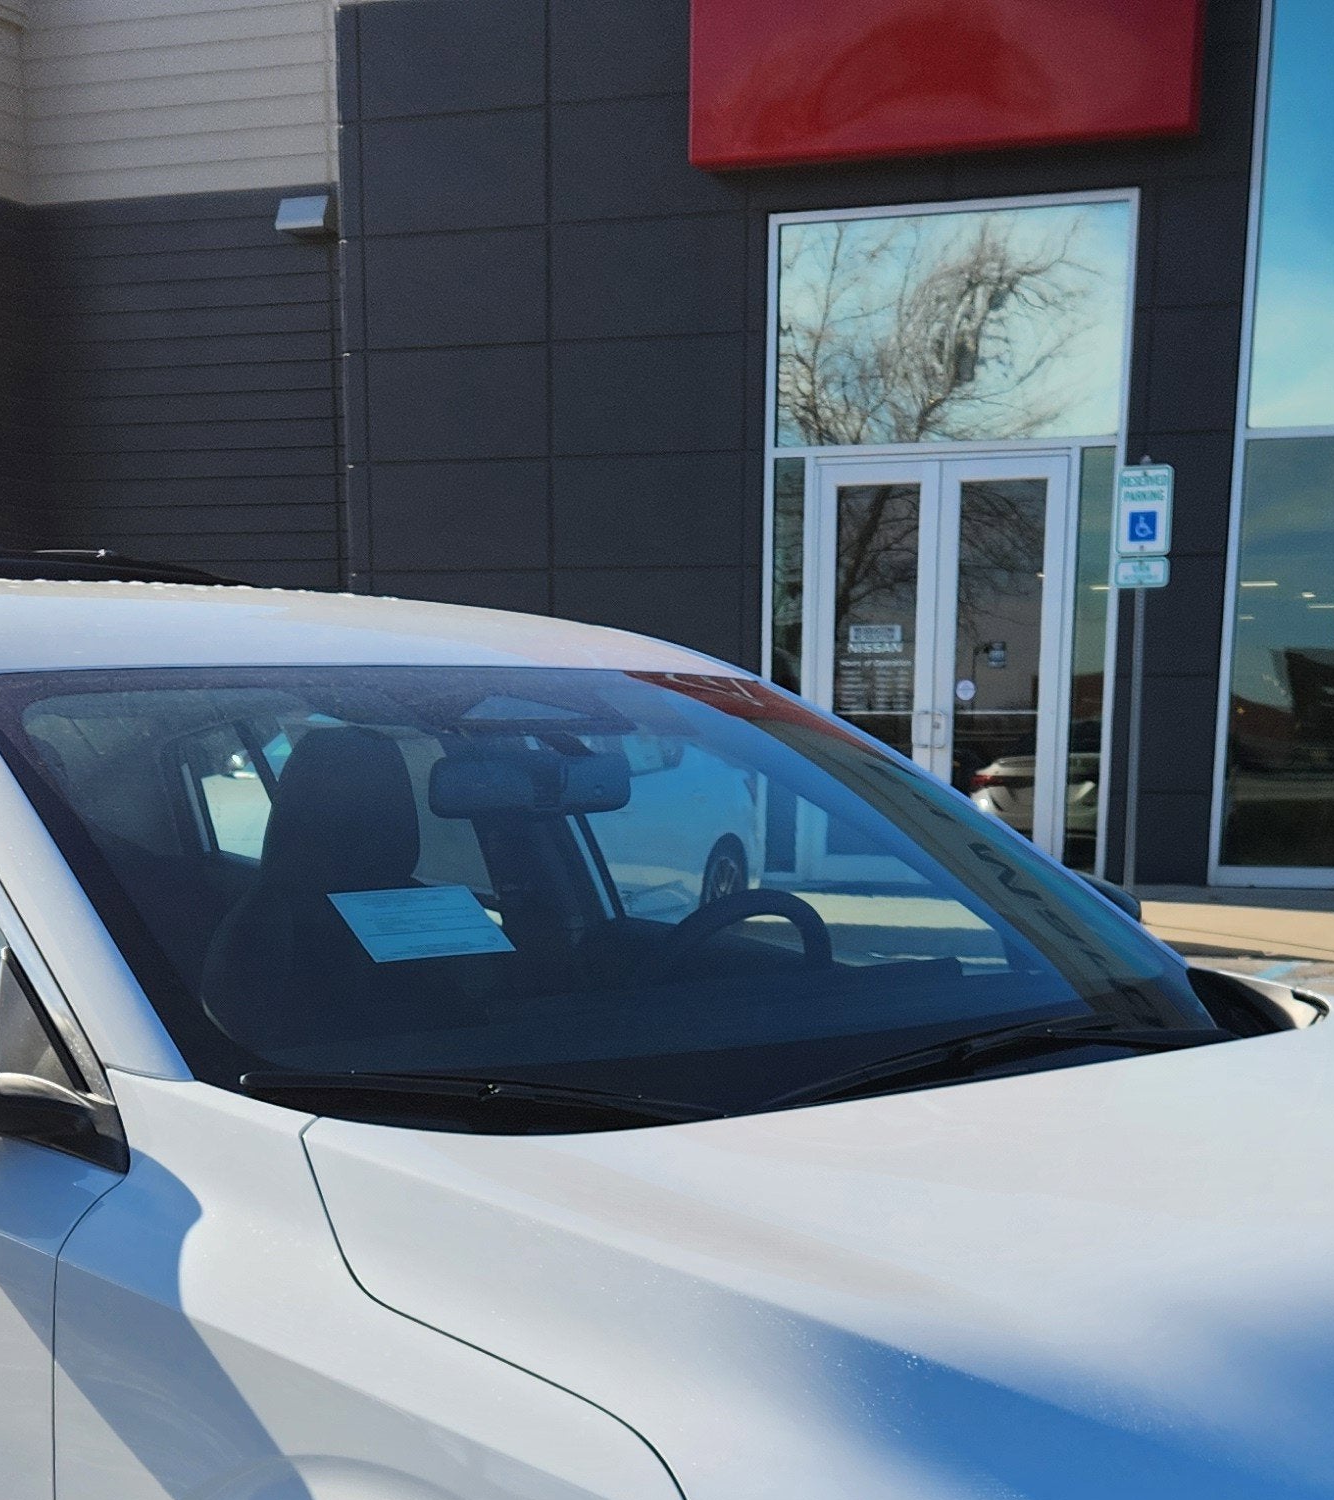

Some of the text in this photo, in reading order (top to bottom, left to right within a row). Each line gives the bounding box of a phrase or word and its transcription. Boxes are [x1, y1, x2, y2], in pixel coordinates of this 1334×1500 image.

[1121, 475, 1167, 487] RESERVED
[1123, 490, 1165, 502] PARKING
[848, 642, 903, 653] NISSAN
